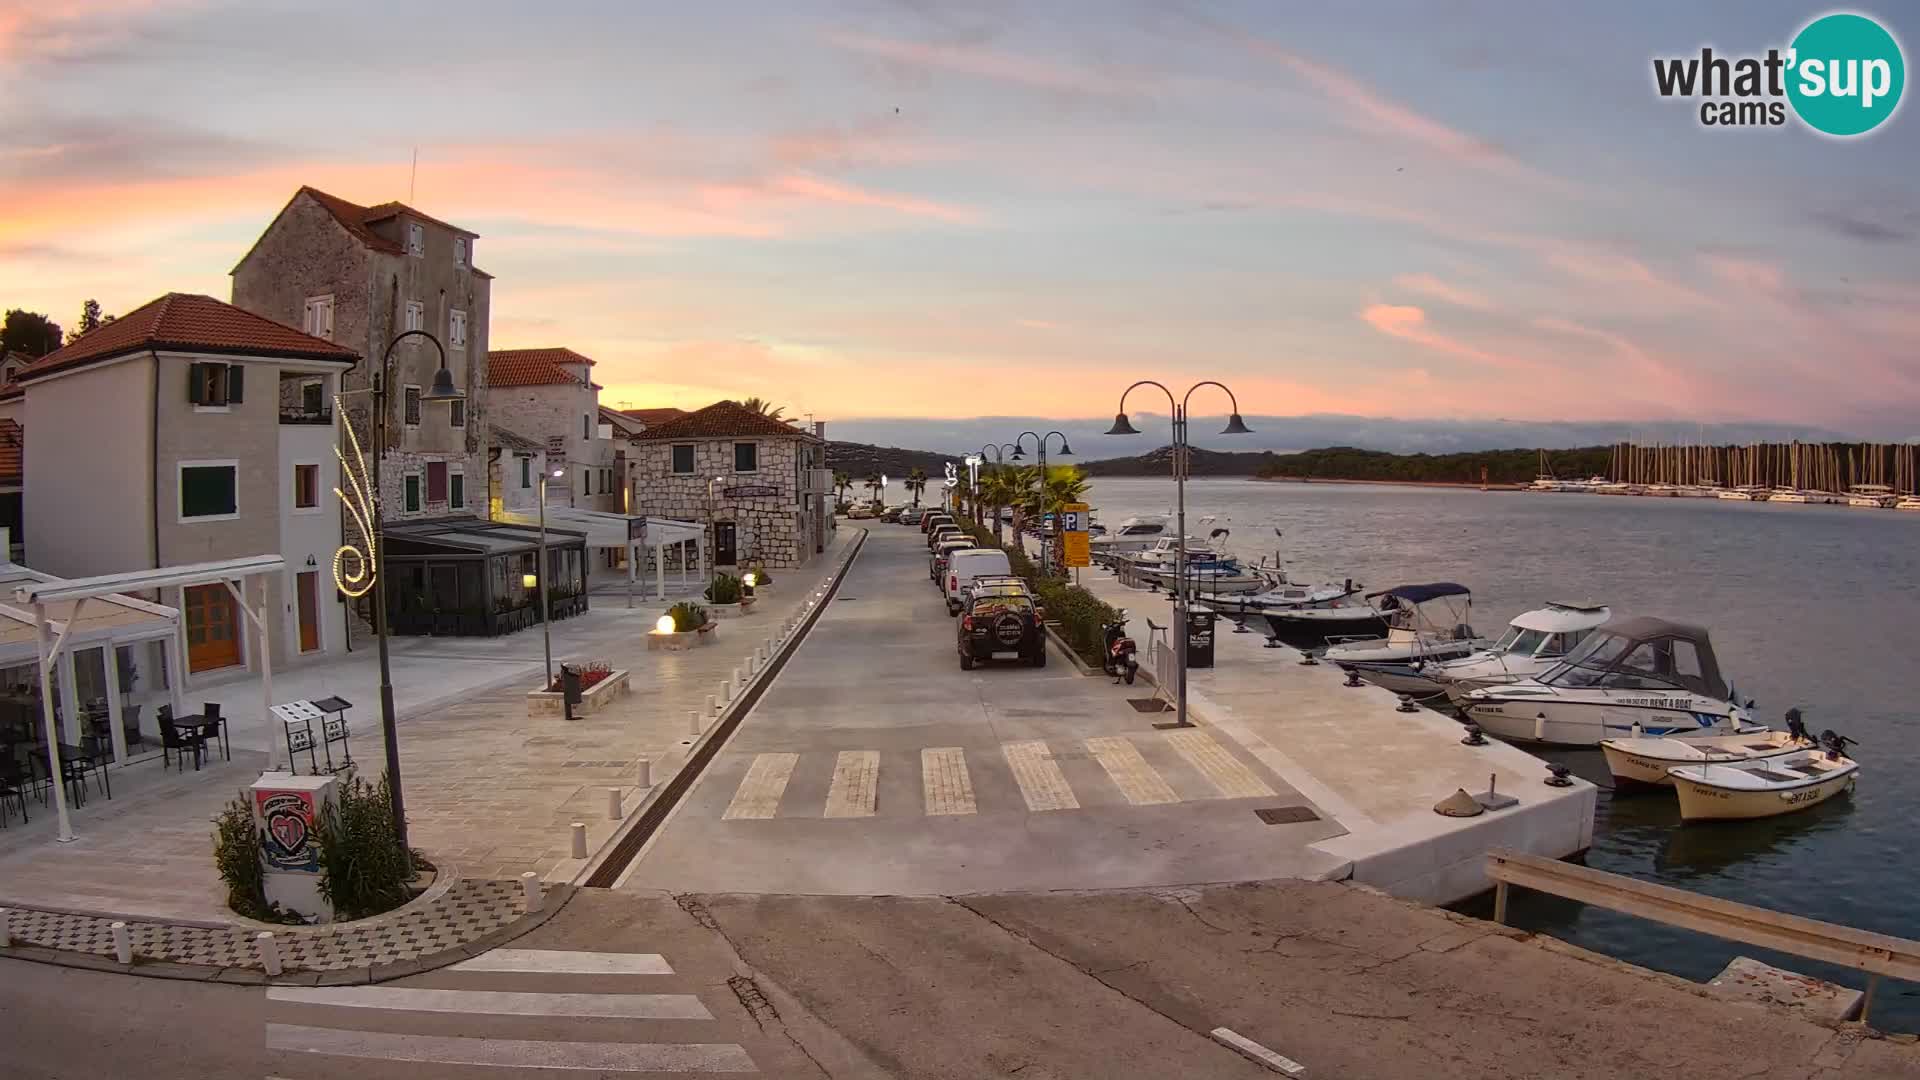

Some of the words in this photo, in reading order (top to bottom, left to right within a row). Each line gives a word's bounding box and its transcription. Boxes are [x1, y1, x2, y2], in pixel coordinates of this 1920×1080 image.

[1066, 514, 1076, 529] P
[1649, 698, 1669, 708] RENT
[1675, 699, 1692, 709] BOAT
